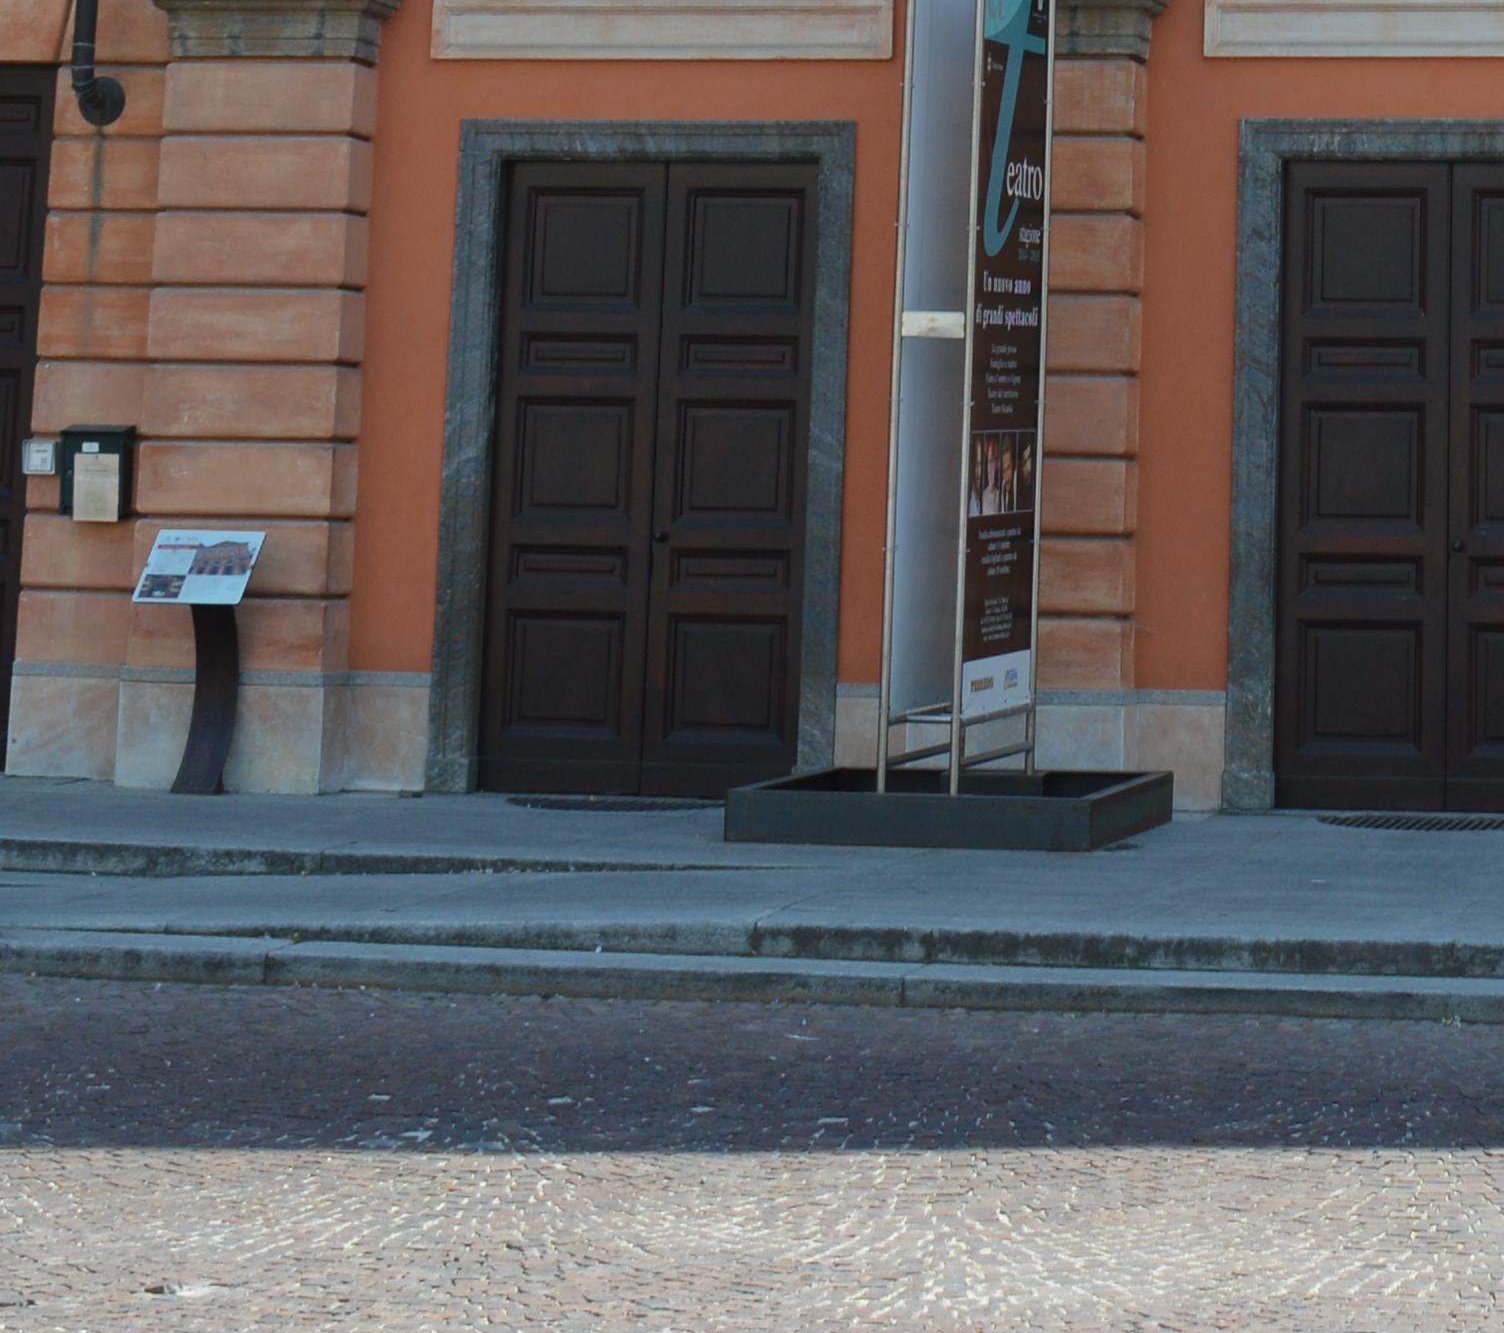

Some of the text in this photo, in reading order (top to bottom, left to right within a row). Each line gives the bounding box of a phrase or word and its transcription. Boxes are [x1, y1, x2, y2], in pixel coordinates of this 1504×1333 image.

[983, 270, 1032, 294] Un nuovo anno
[976, 302, 1039, 332] di grandi spettacoli
